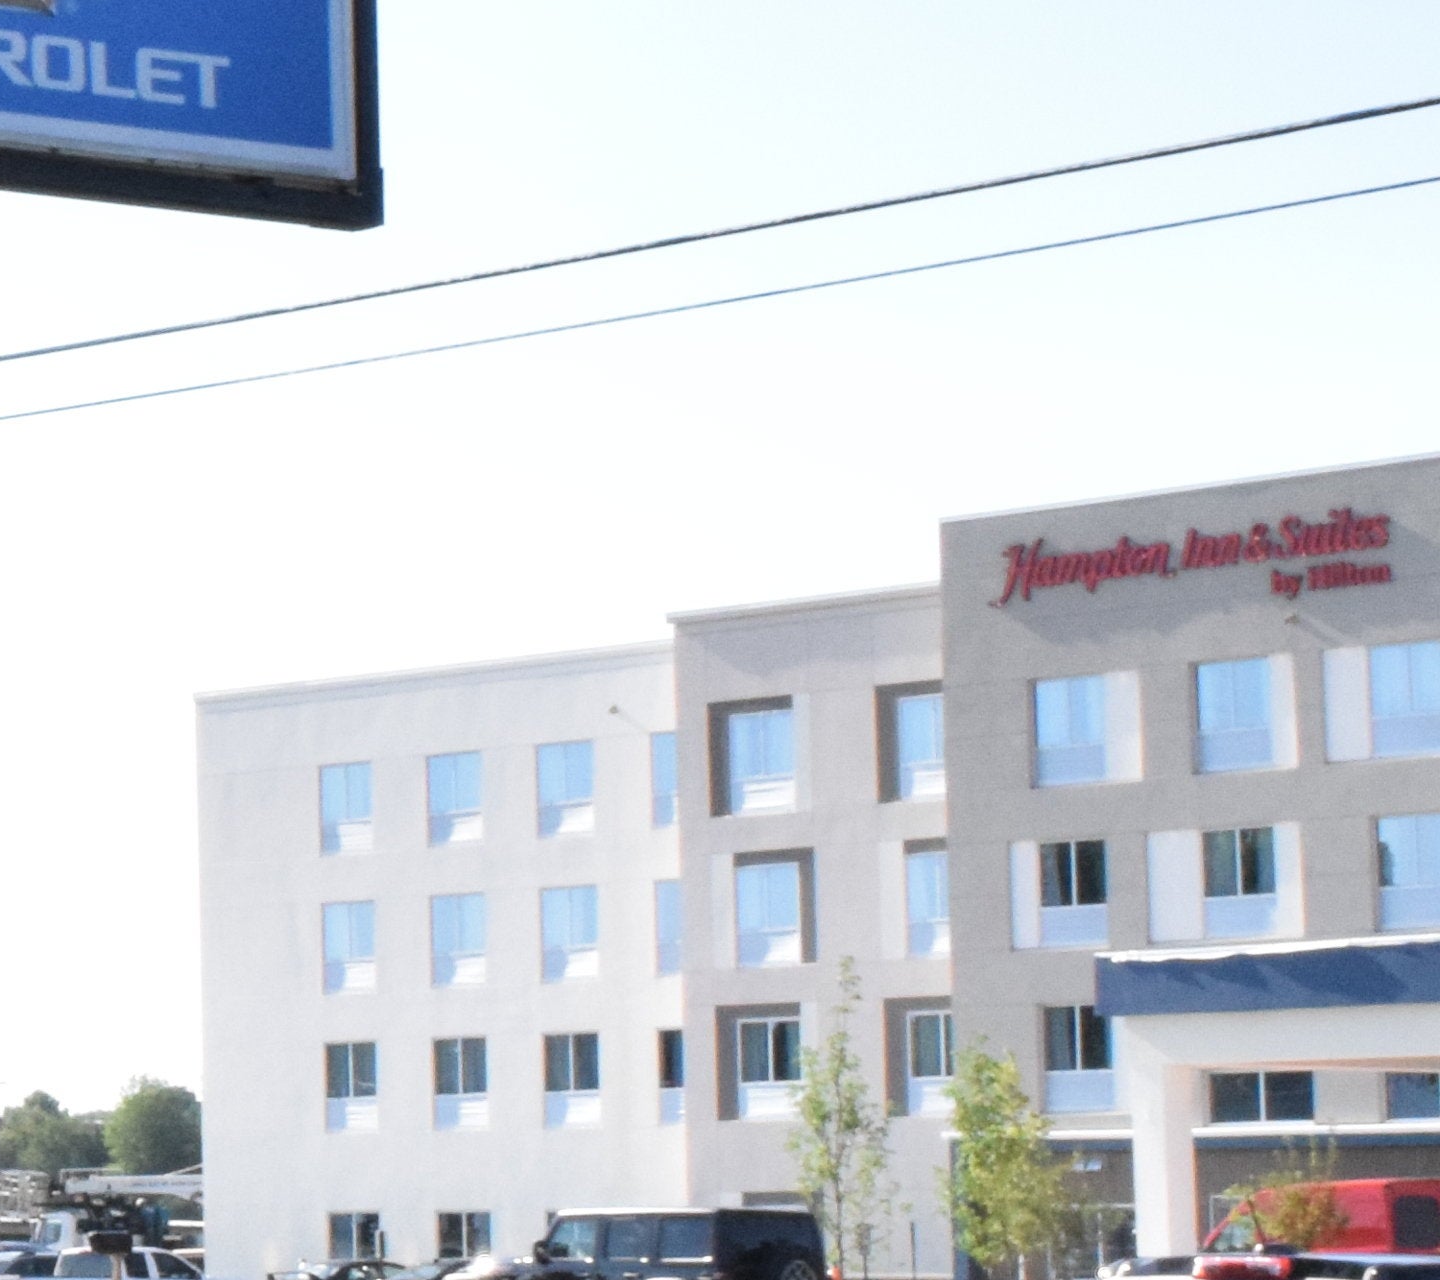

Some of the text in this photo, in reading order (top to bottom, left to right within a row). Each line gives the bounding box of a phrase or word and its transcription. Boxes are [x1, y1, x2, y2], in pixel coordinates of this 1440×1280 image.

[988, 507, 1390, 607] Hampton Inn & Suites
[1271, 570, 1302, 599] by
